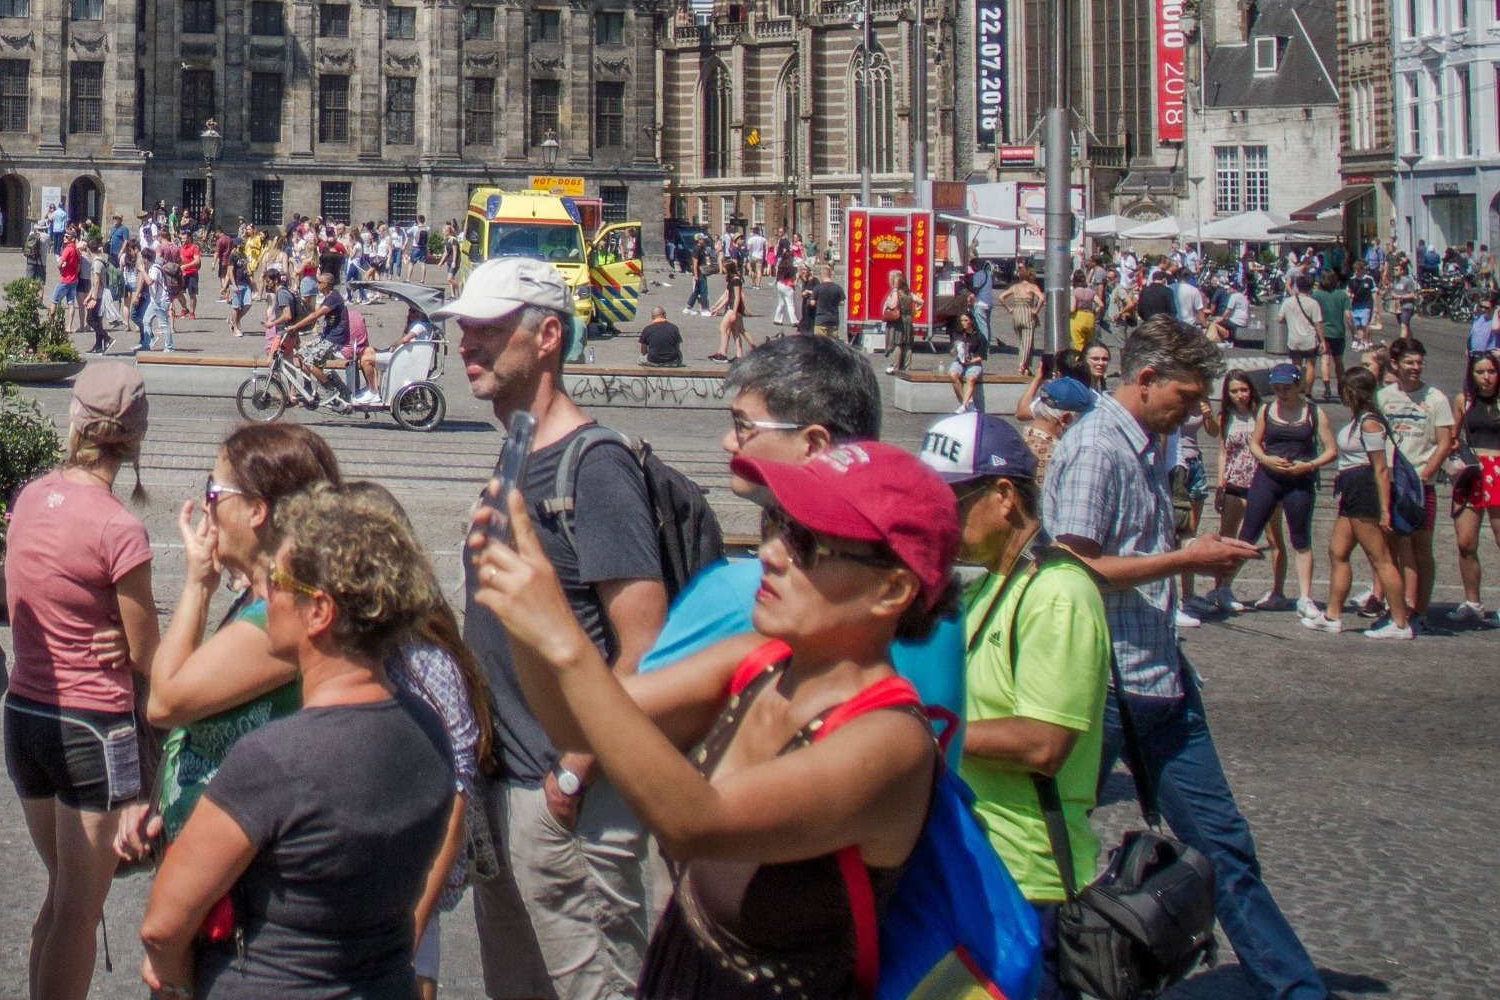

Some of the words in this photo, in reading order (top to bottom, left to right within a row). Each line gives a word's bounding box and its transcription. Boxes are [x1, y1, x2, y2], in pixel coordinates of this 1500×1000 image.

[980, 6, 1002, 131] 22.07.2018
[1165, 62, 1185, 125] 2018
[533, 178, 582, 186] HOT-DOGS
[914, 265, 924, 318] DRINS
